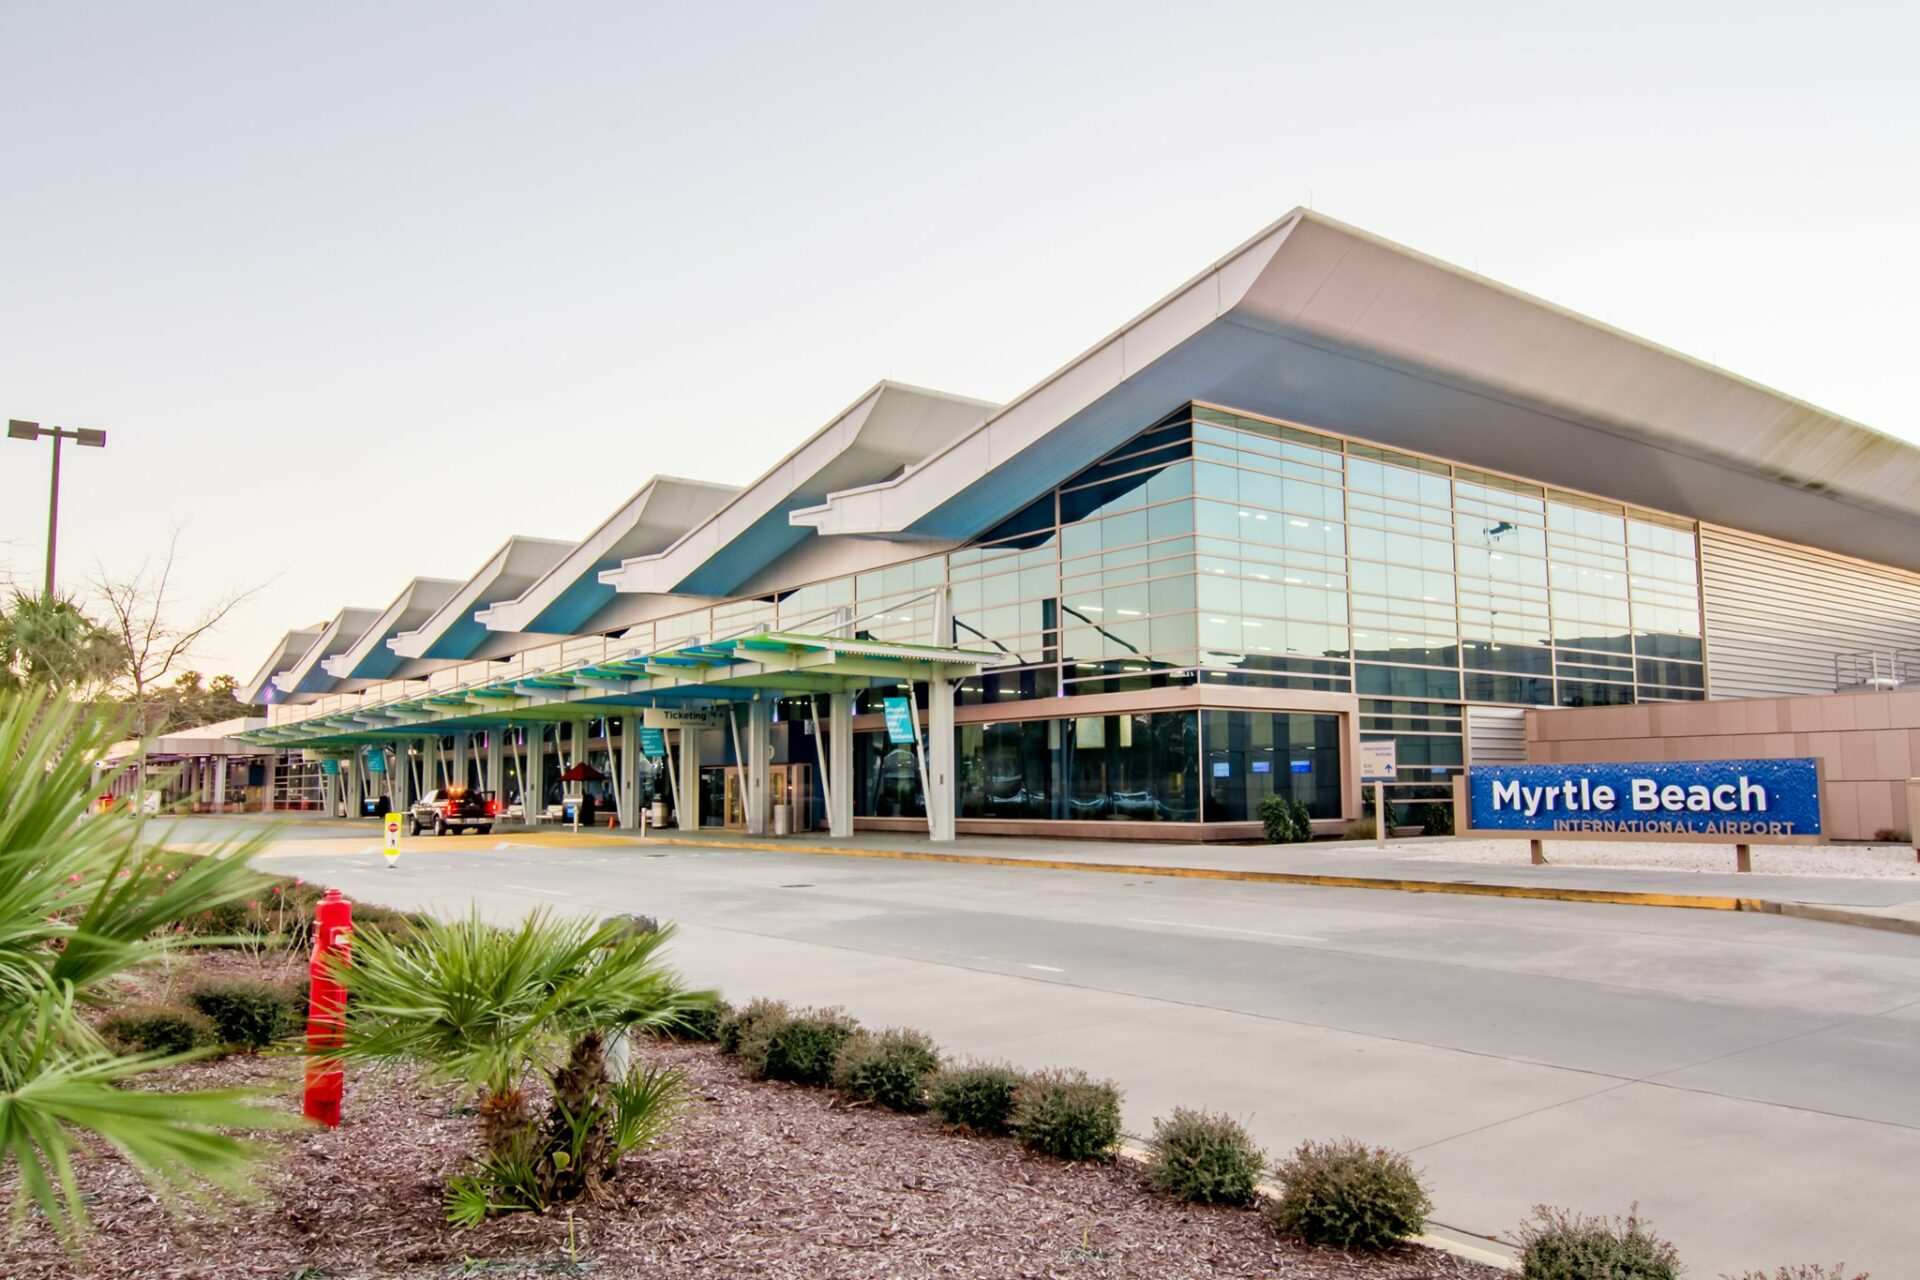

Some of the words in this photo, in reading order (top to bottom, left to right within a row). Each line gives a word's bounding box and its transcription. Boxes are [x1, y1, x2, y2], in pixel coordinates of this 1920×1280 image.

[664, 710, 707, 721] Ticketing
[1492, 778, 1616, 817] Myrtle
[1631, 776, 1767, 811] Beach
[1553, 819, 1698, 833] INTERNATIONAL
[1705, 820, 1795, 836] AIRPORT
